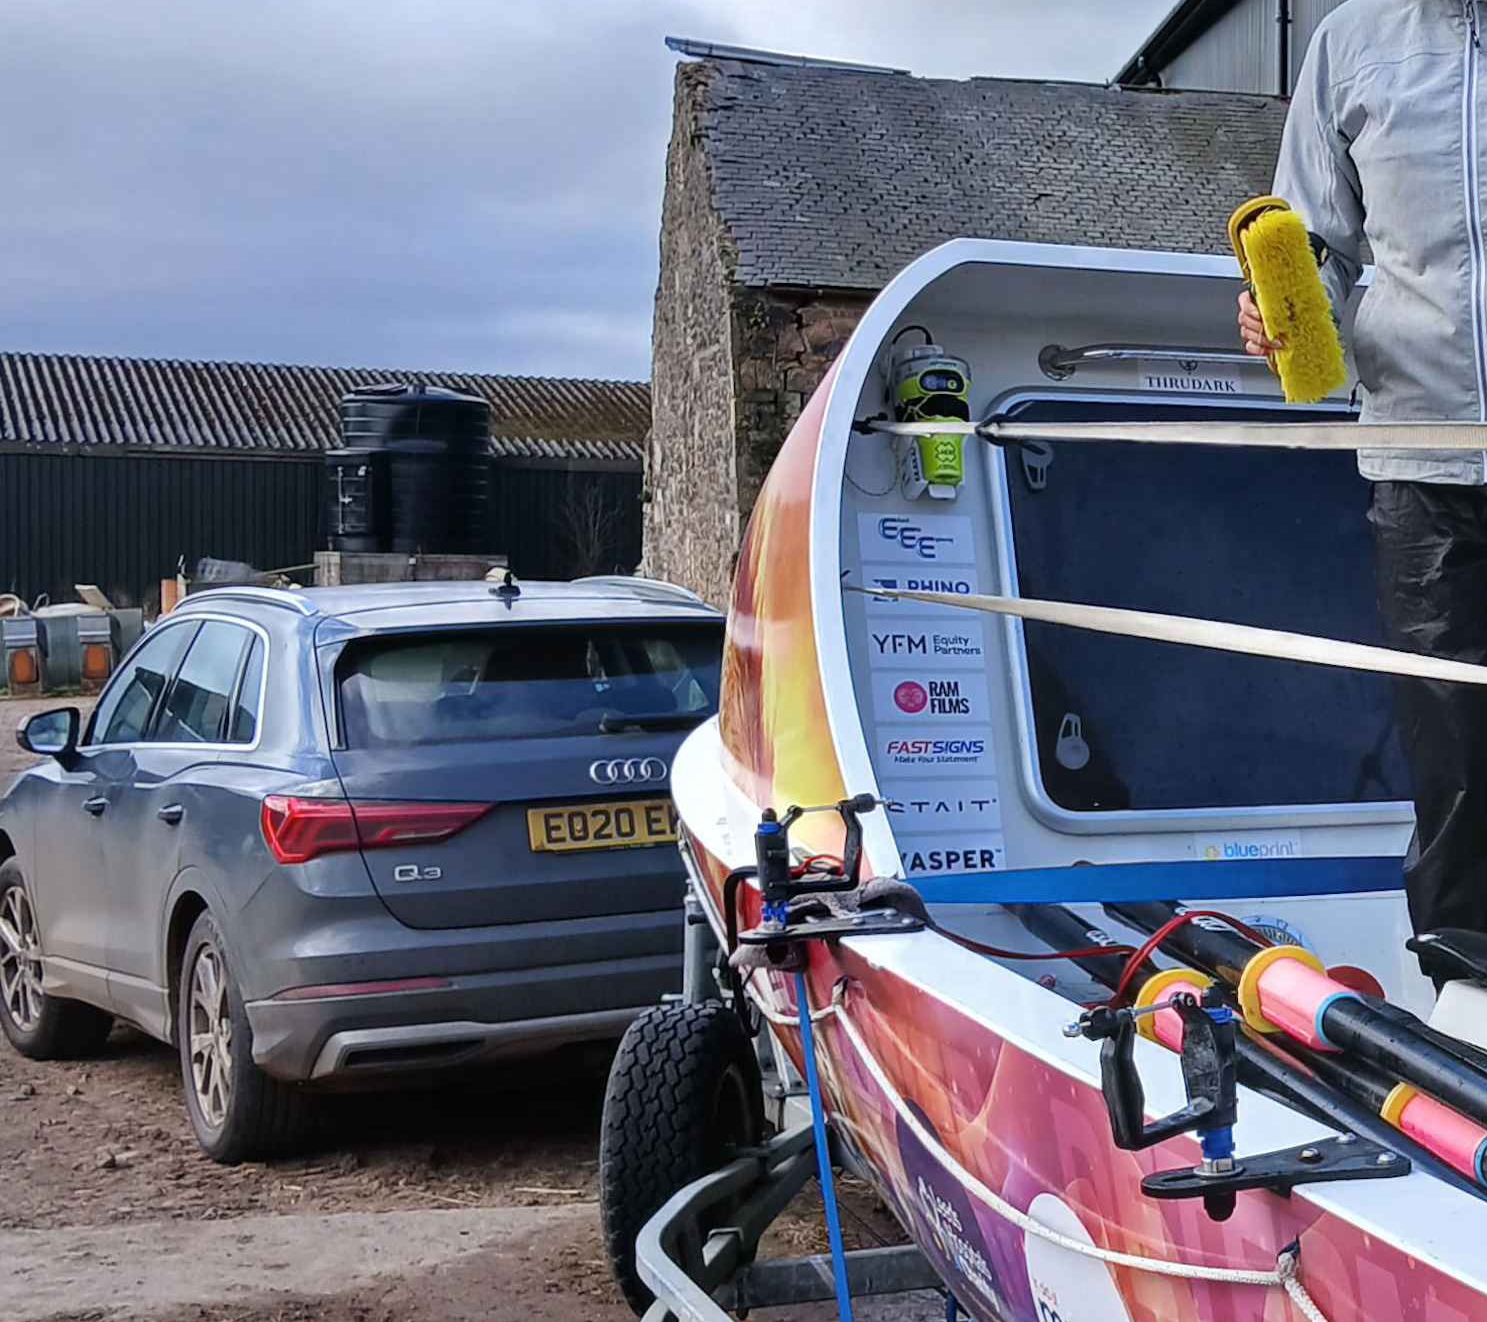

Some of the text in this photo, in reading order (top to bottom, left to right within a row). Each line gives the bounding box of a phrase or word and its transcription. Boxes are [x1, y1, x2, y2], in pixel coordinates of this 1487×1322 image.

[1144, 375, 1236, 393] THRUDARK
[872, 633, 928, 655] YFM
[932, 634, 970, 647] Equity
[933, 645, 982, 656] Partners
[928, 681, 960, 698] RAM
[929, 697, 971, 714] FILMS
[886, 740, 985, 755] FASTSIGNS
[1223, 840, 1296, 859] blueprint
